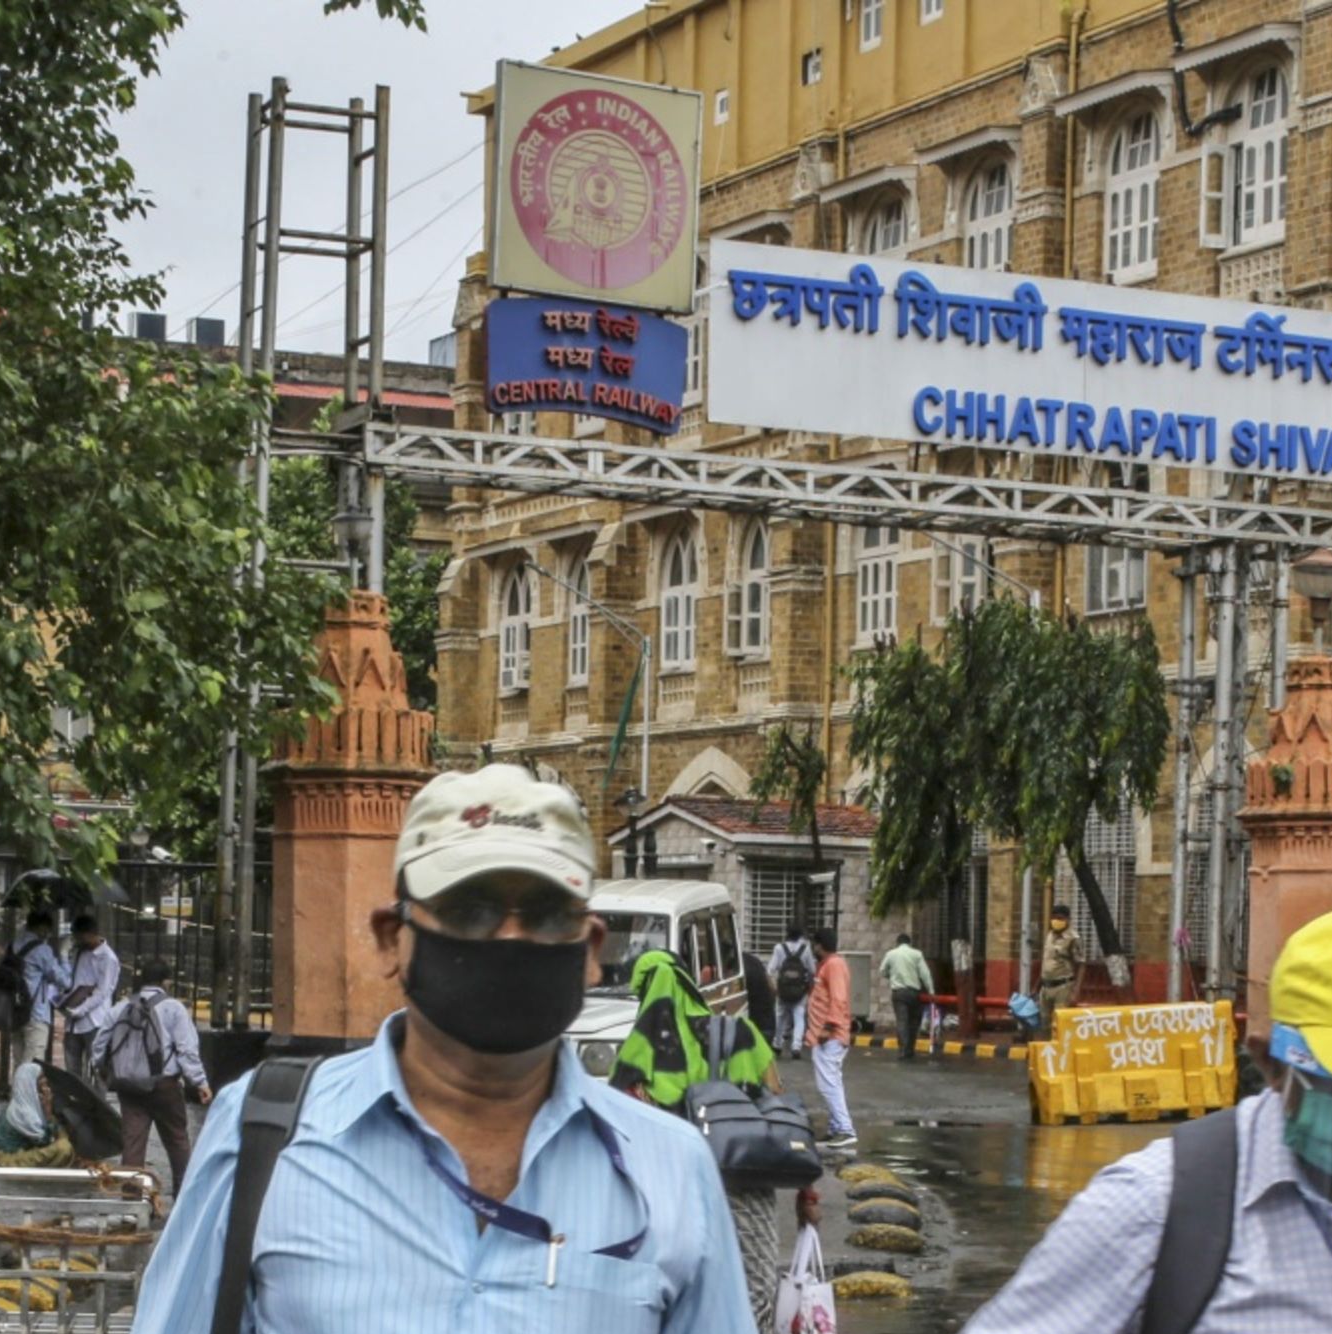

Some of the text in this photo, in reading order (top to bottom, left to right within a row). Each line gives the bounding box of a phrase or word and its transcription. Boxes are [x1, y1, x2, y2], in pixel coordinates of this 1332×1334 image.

[596, 97, 662, 149] INDIAN
[543, 310, 592, 332] मध्य
[728, 263, 884, 335] छत्रपती
[895, 270, 1048, 352] शिवाजी
[1059, 307, 1207, 369] महाराज
[546, 344, 636, 378] मध्य रेल
[494, 378, 684, 425] CENTRAL RAILWAY
[913, 386, 1217, 464] CHHATRAPATI
[1072, 1009, 1123, 1039] मेल
[1104, 1025, 1166, 1069] प्रवेश
